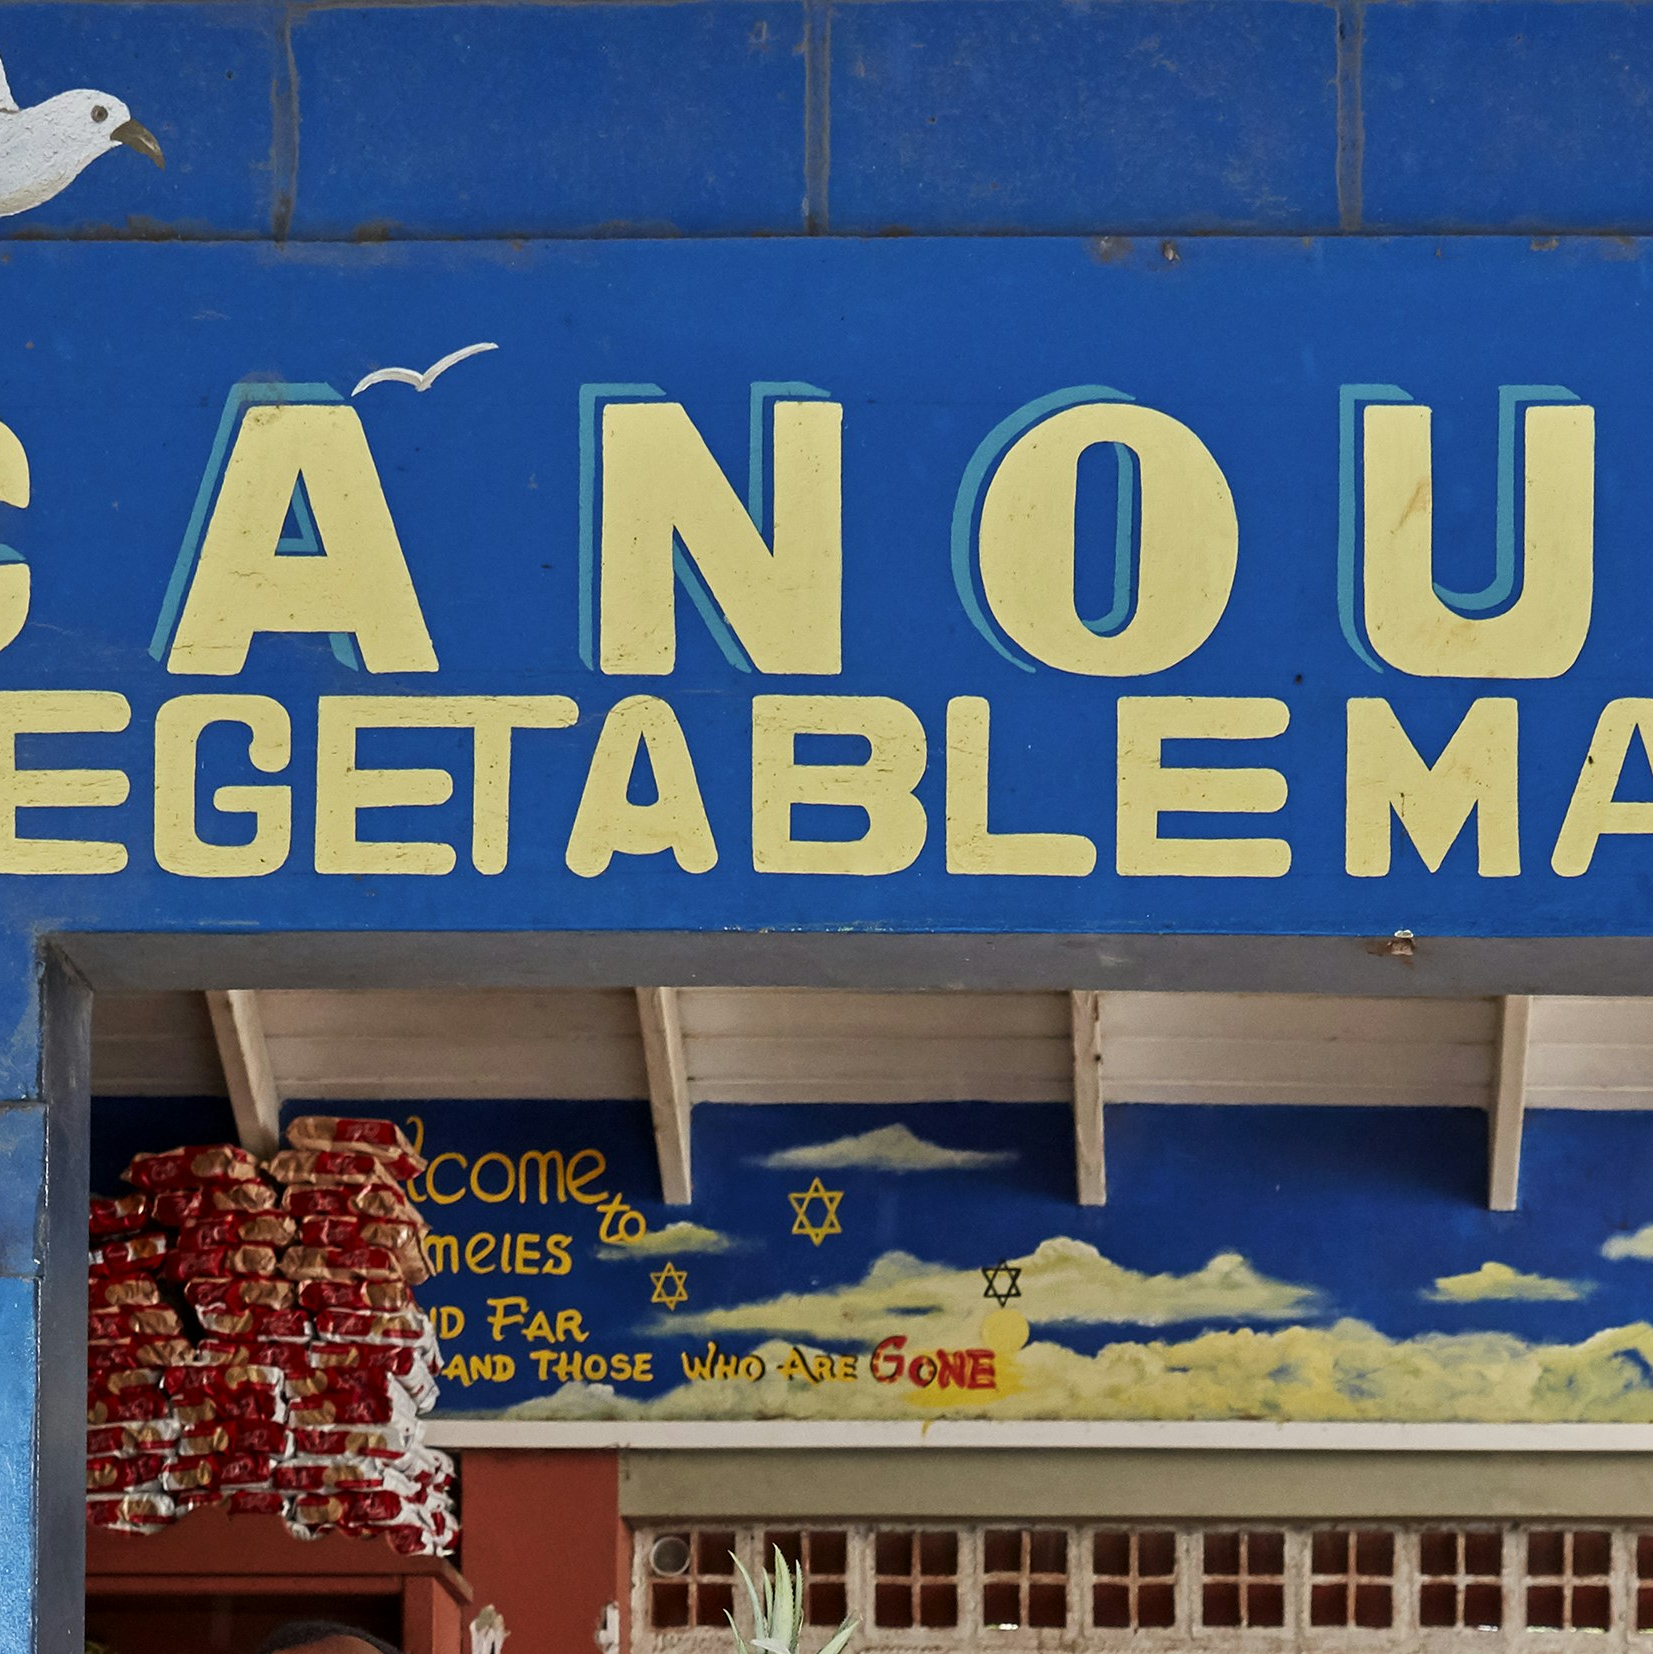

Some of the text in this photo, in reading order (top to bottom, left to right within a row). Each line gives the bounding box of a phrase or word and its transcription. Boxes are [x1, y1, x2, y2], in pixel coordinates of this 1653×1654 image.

[597, 1193, 647, 1244] to
[441, 1335, 997, 1390] AND THOSE WHO ARE GONE
